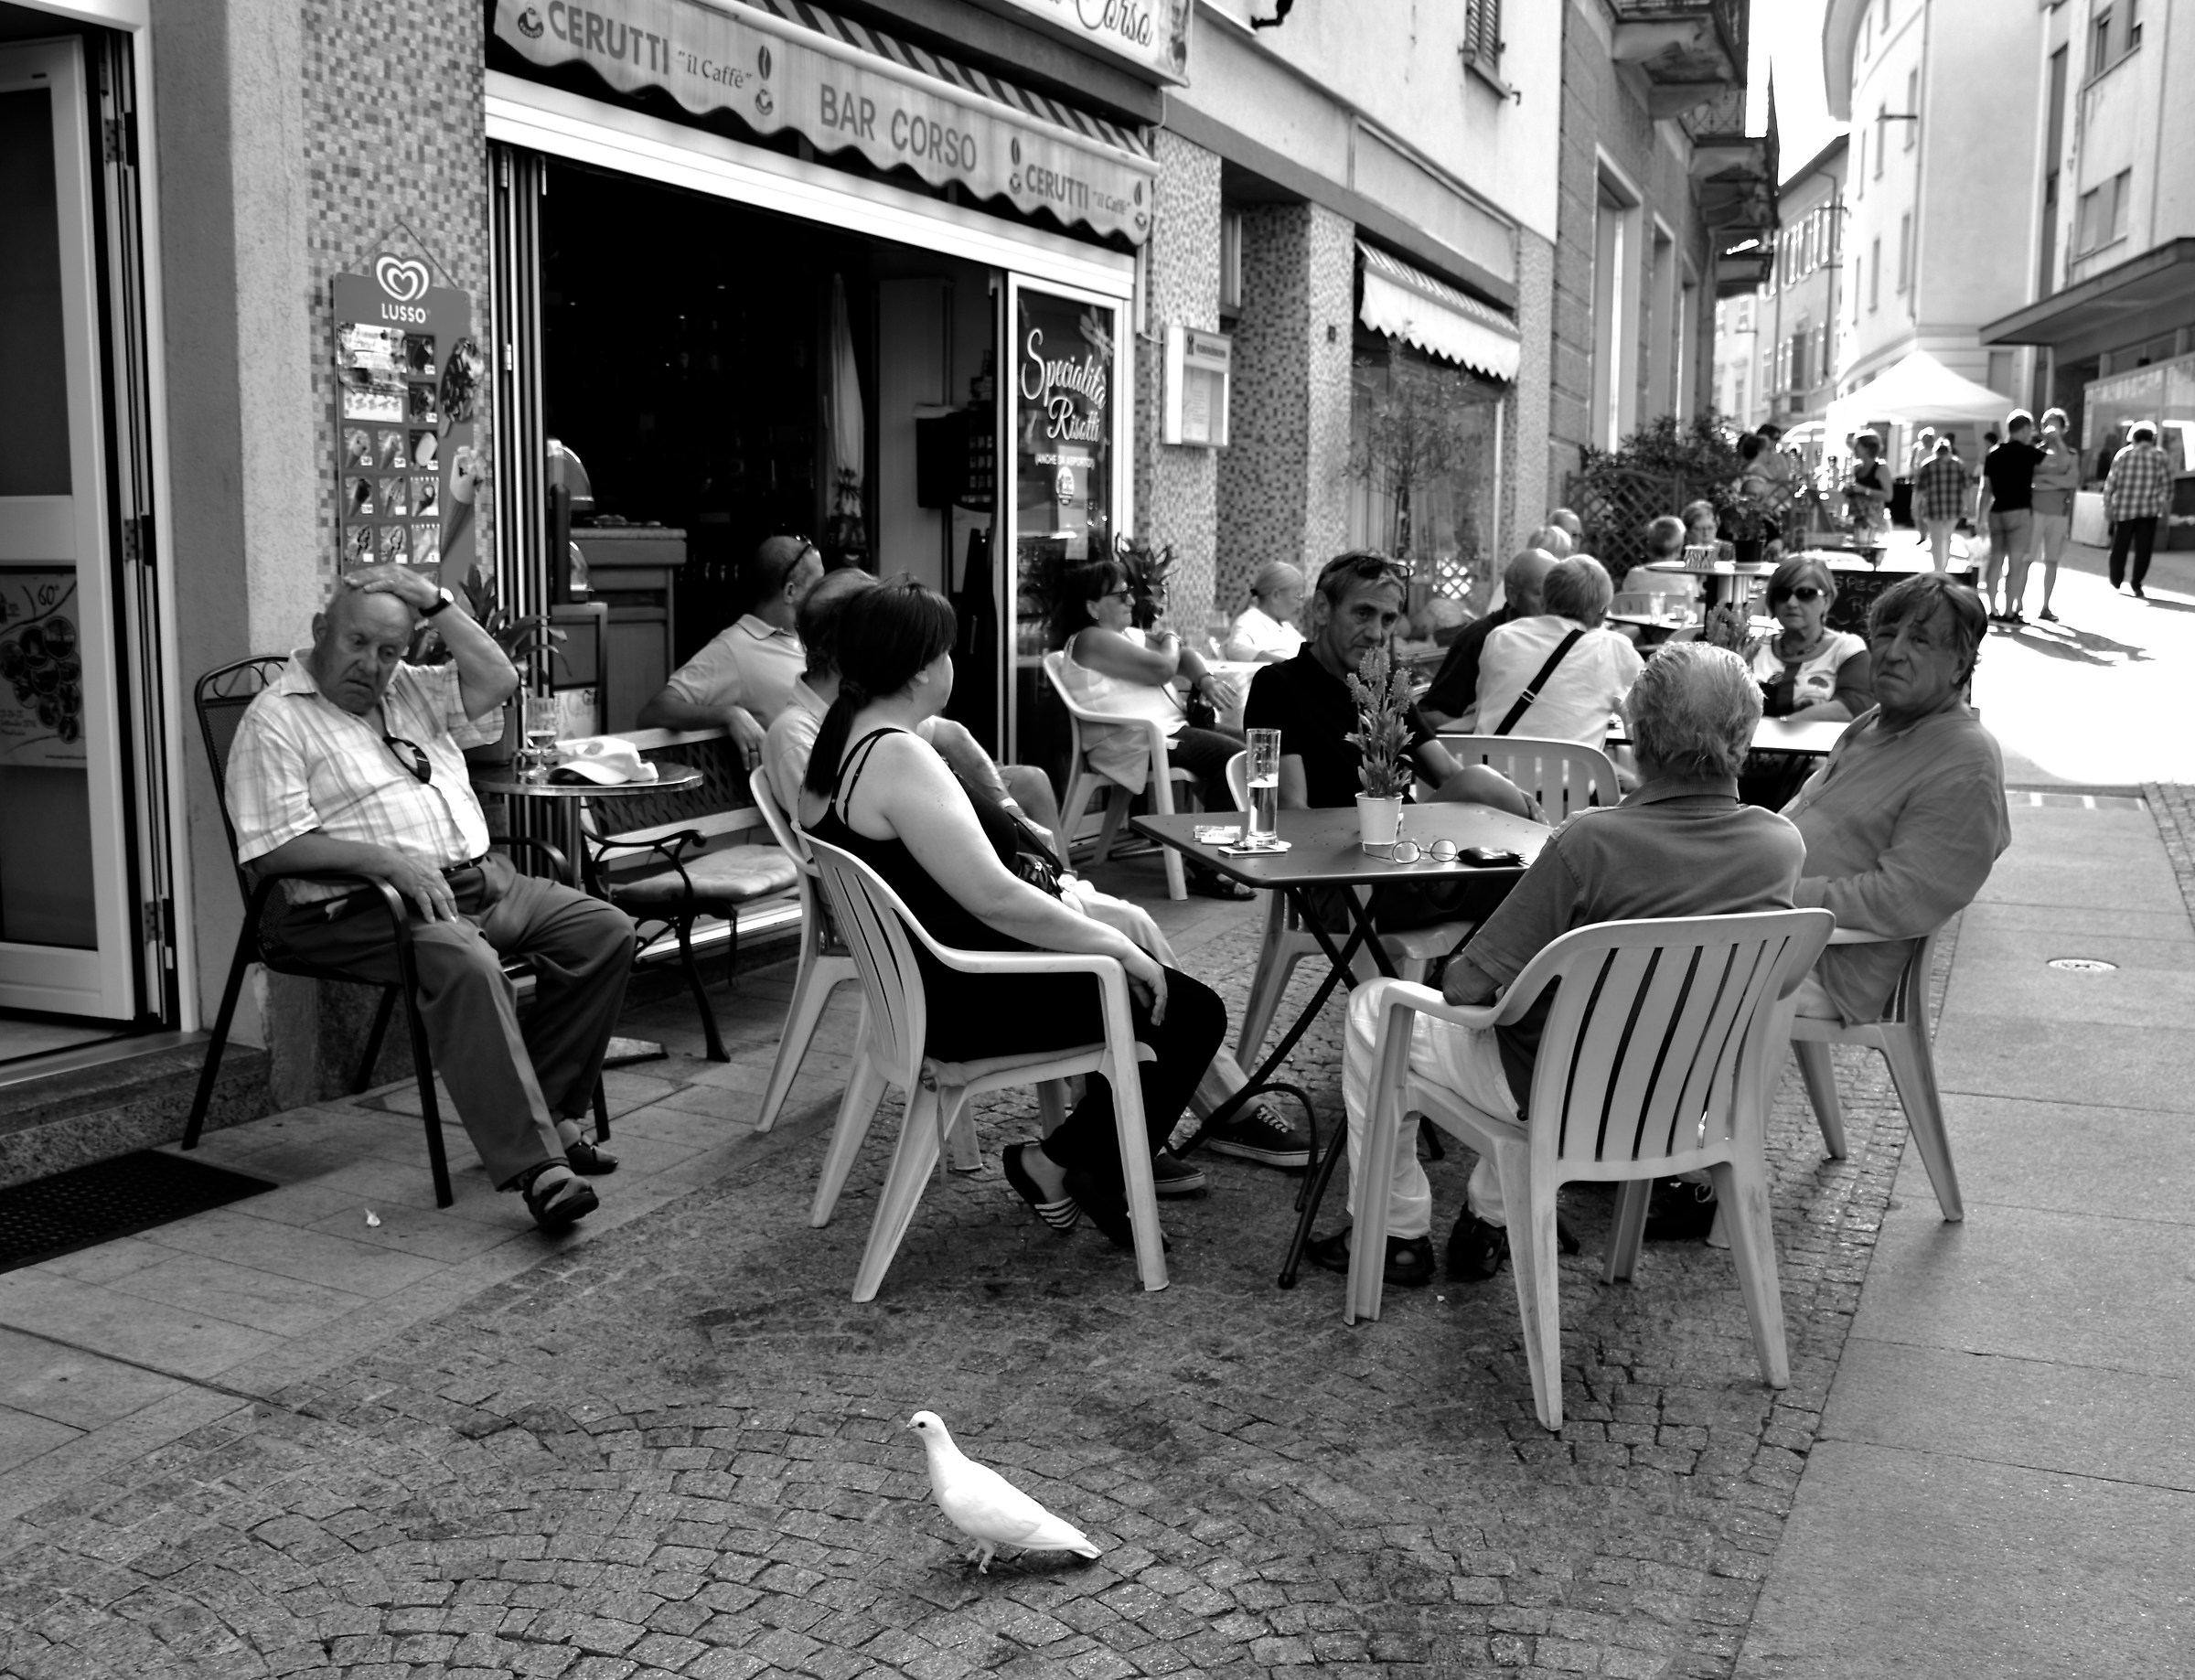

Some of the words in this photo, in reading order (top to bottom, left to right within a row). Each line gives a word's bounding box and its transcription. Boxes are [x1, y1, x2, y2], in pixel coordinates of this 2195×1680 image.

[549, 0, 669, 75] CERUTTI
[820, 83, 875, 141] BAR
[891, 109, 977, 174] CORSO
[1026, 164, 1089, 210] CERUTTI
[381, 303, 427, 326] LUSSO
